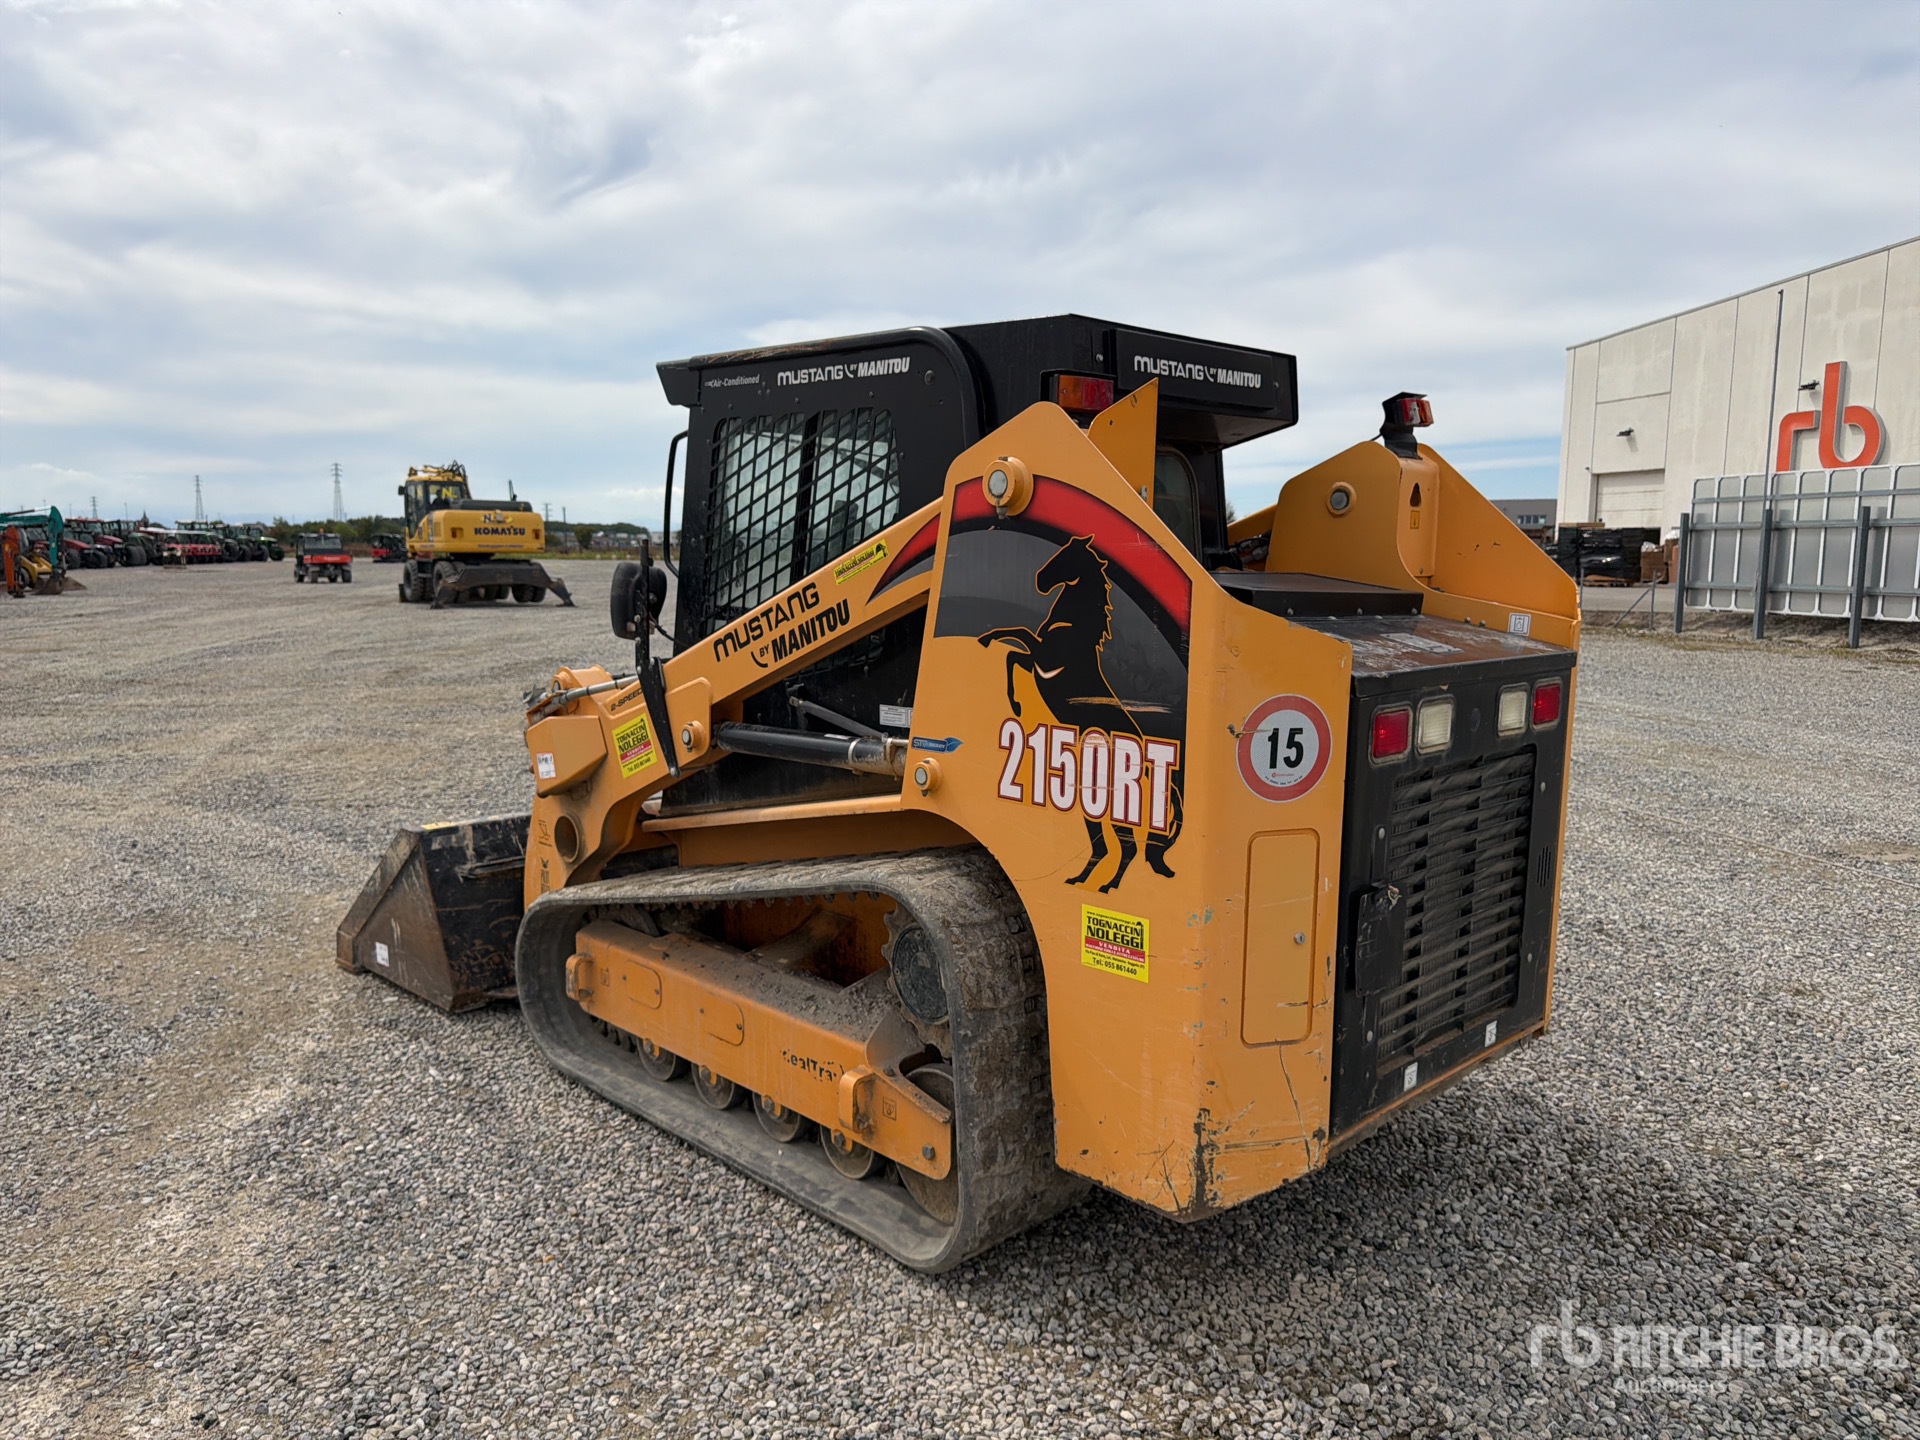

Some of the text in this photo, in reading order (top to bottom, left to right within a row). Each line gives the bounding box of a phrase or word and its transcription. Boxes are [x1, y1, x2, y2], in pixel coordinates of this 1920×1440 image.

[713, 374, 760, 387] Air-Conditioned
[777, 365, 844, 386] MUSTANG
[857, 357, 910, 377] MANITOU
[1133, 355, 1261, 388] MUSTANG BY MANITOU
[474, 526, 525, 536] KOMATSU
[714, 582, 820, 663] MUSTANG
[759, 598, 850, 663] BY MANITOU
[1268, 728, 1304, 769] 15
[998, 717, 1178, 834] 2150RT
[1087, 925, 1144, 950] NOLEGGI
[1098, 941, 1131, 955] VENDITA
[1092, 957, 1103, 967] Tel.
[1104, 961, 1115, 969] 055
[1116, 964, 1137, 976] 861440
